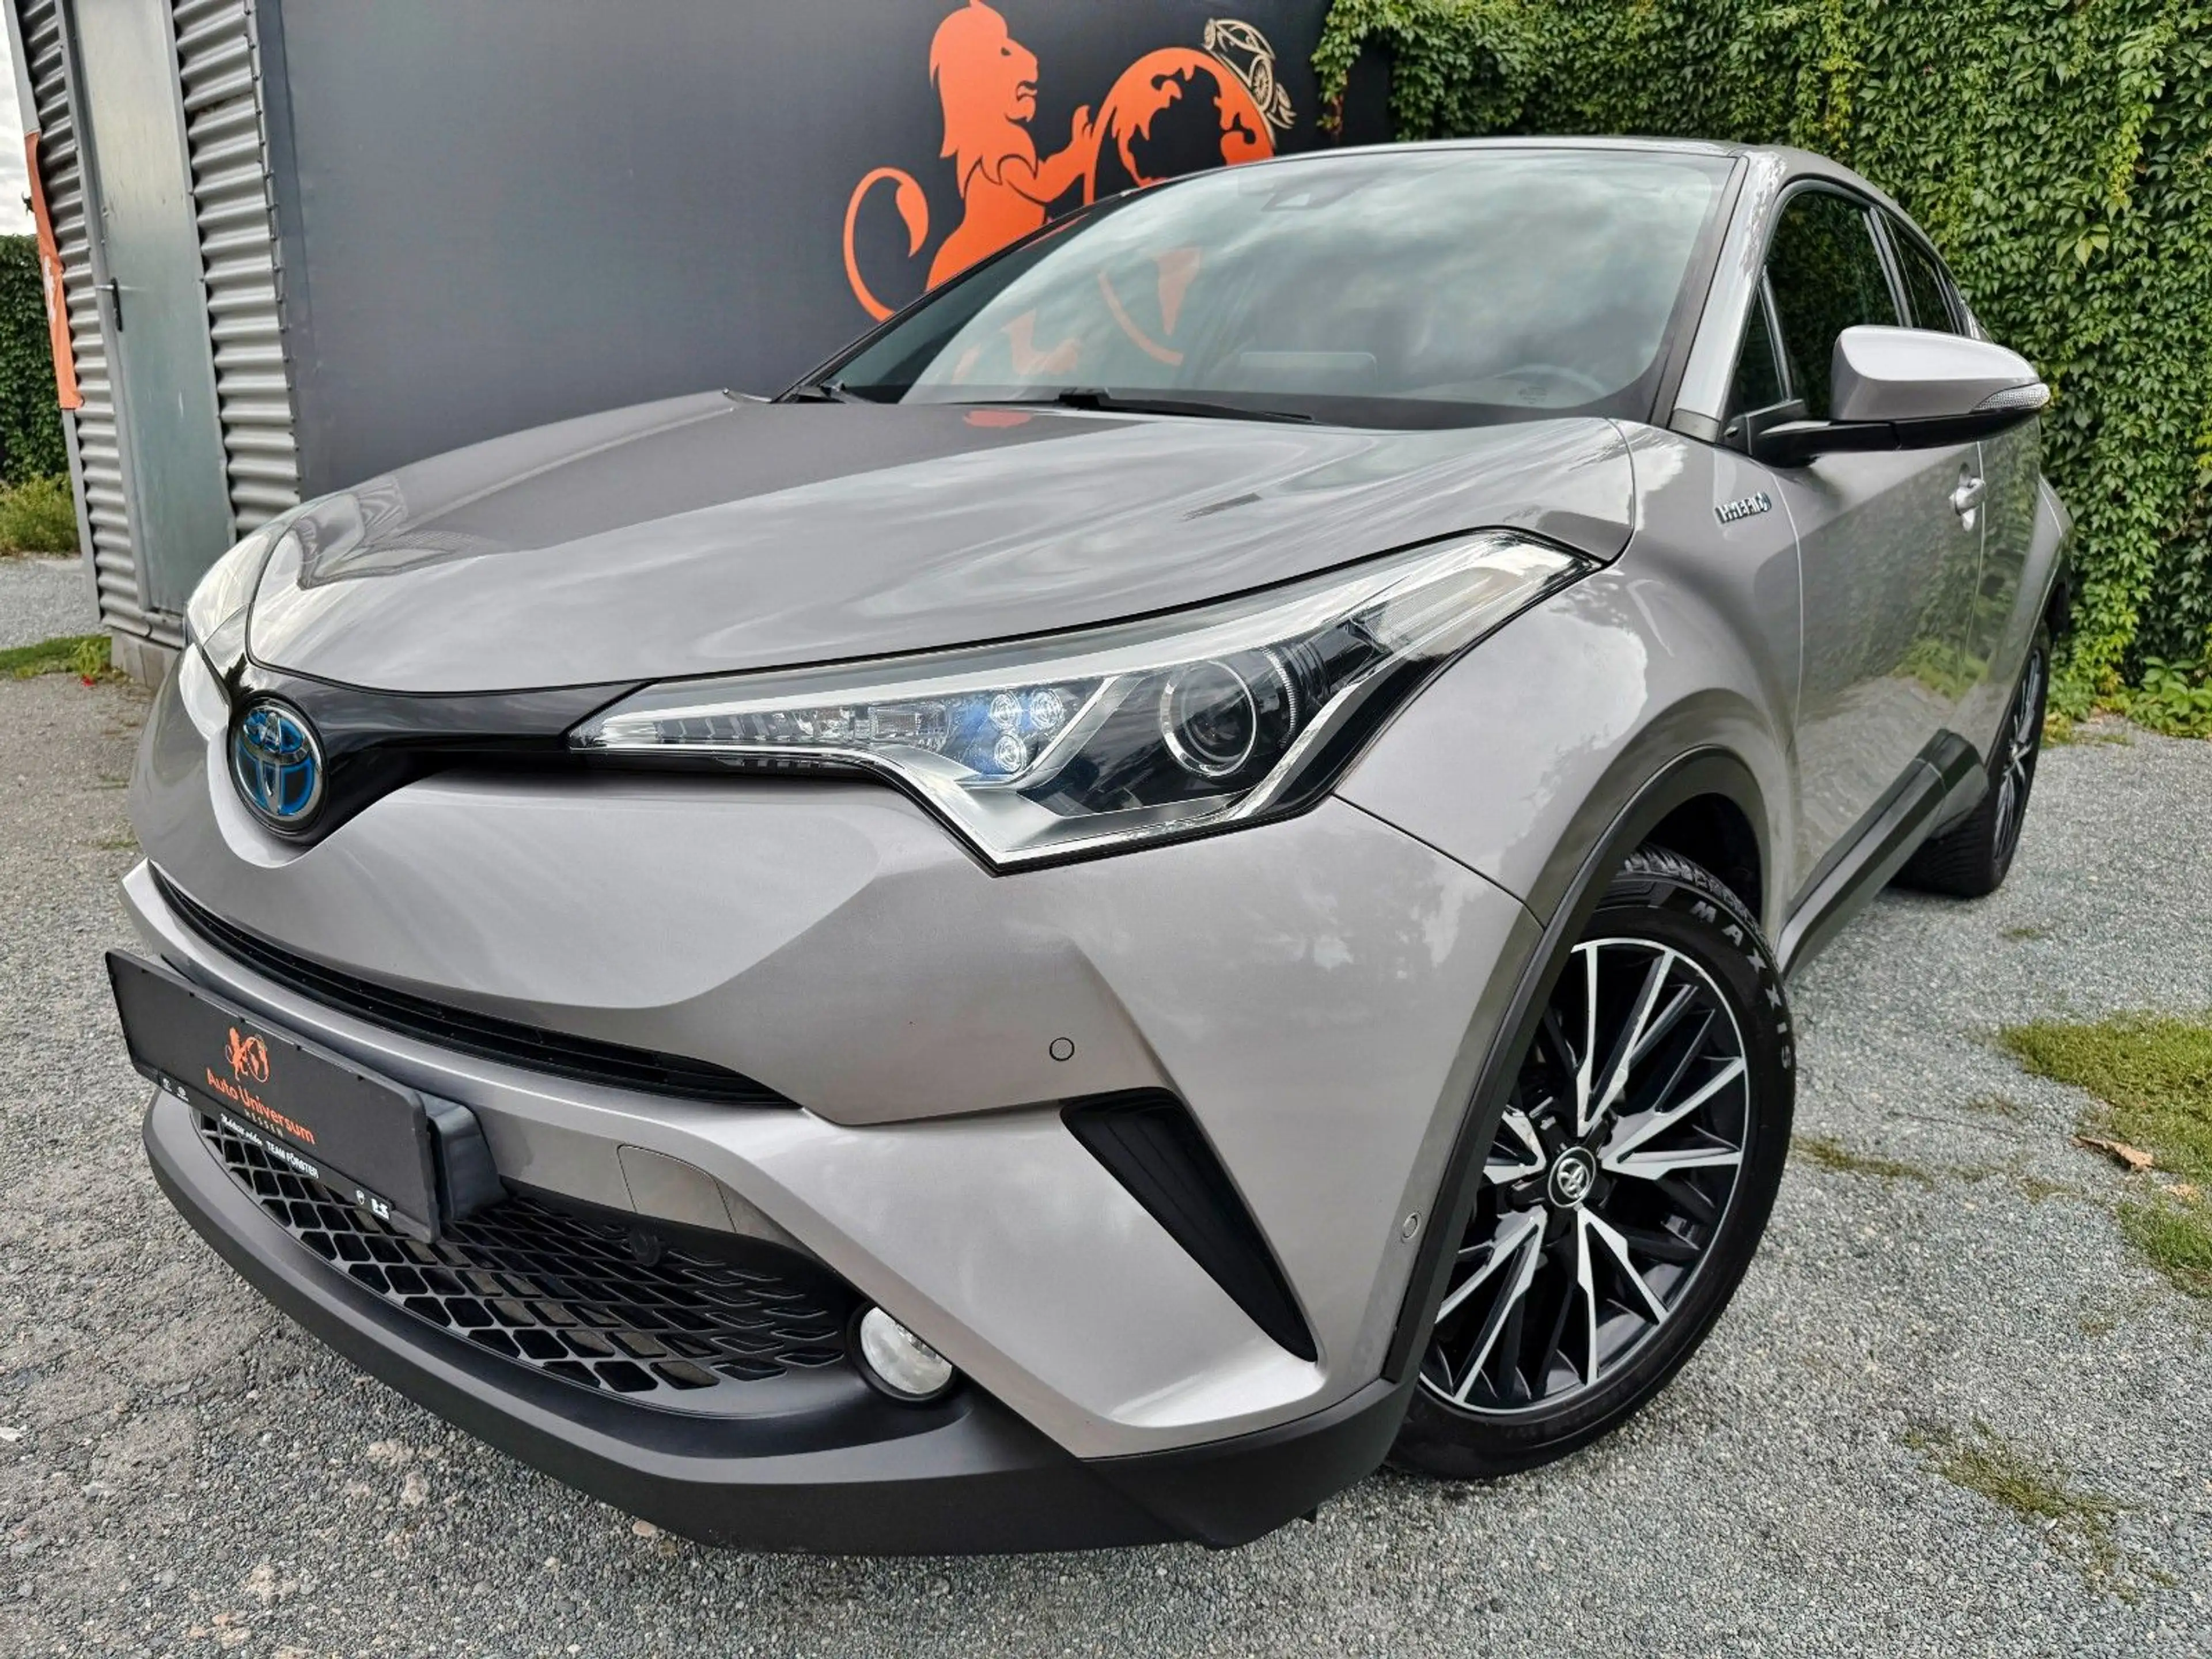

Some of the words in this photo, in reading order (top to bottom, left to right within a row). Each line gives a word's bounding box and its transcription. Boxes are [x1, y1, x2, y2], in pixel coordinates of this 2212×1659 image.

[1715, 491, 1772, 524] HYBRID
[1689, 900, 1791, 1069] MAXXIS
[206, 1067, 239, 1101] Auto
[237, 1085, 316, 1145] Universum
